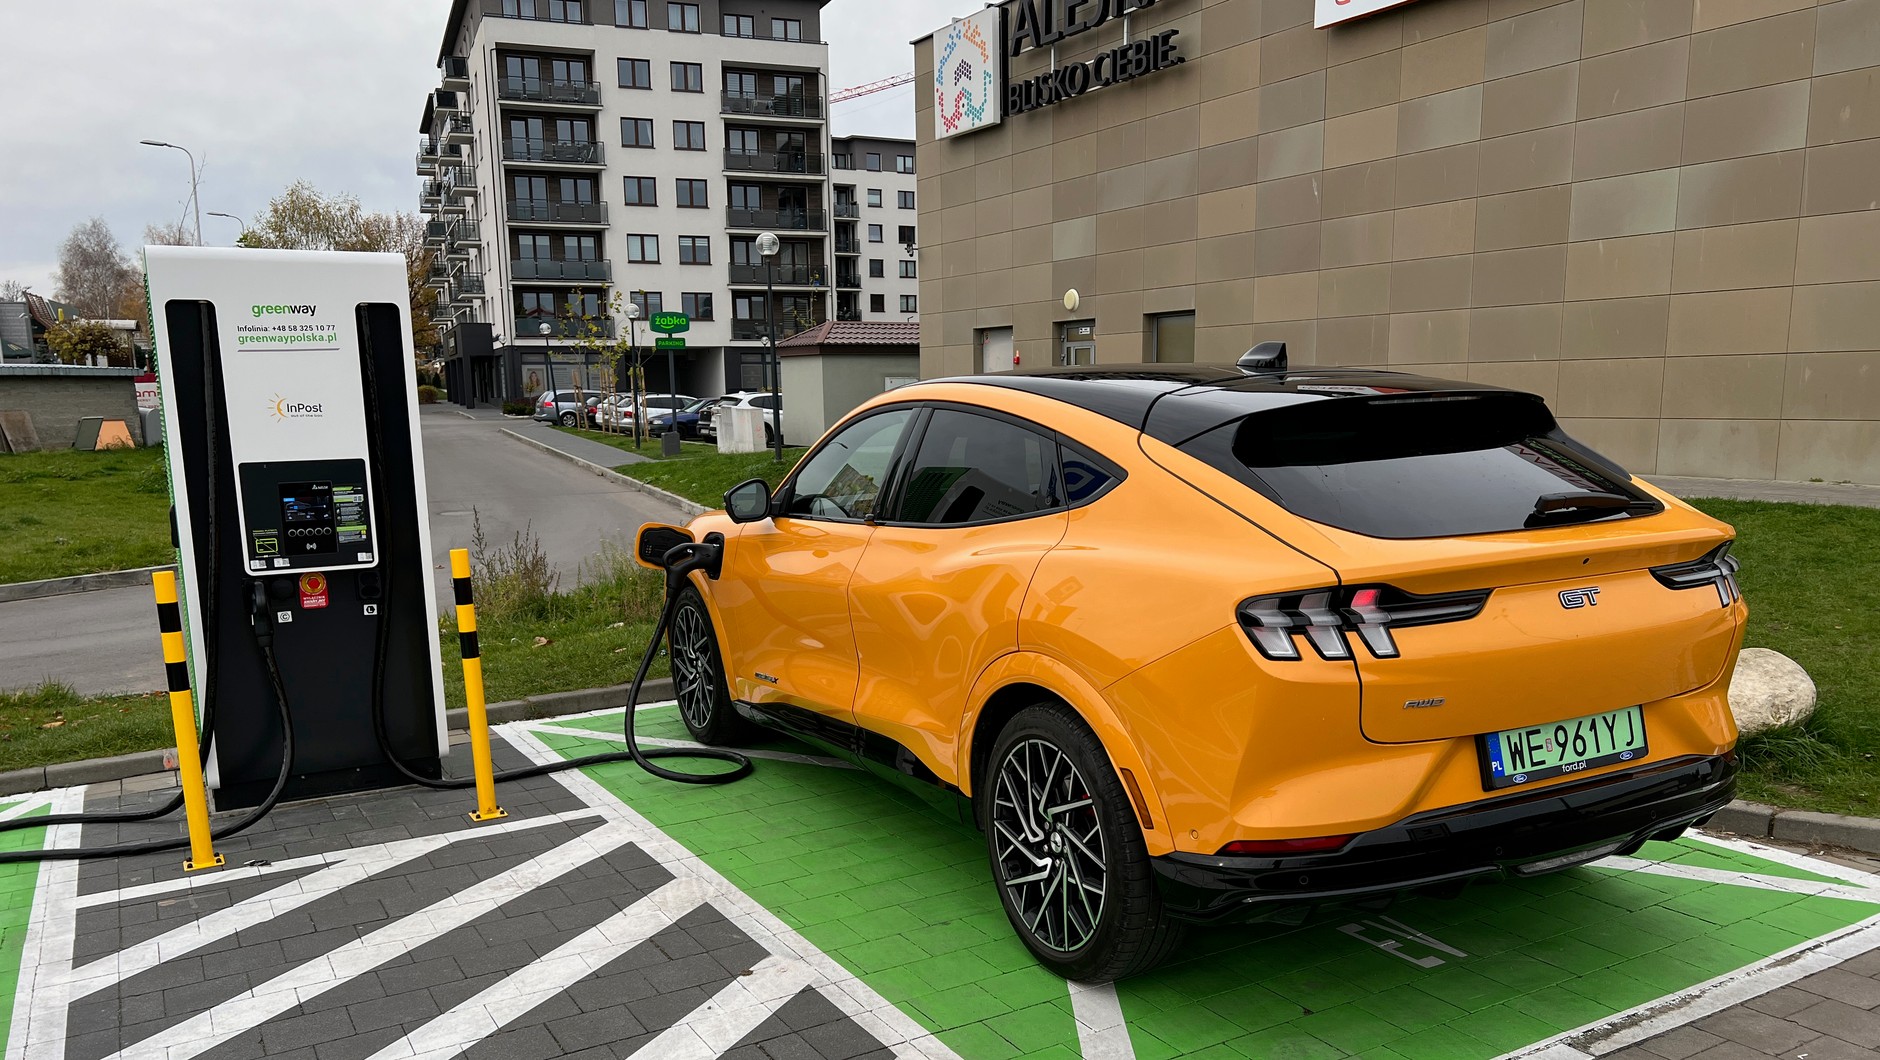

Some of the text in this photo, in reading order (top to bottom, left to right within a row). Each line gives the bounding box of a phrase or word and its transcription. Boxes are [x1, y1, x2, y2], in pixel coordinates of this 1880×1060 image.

[1009, 62, 1090, 115] BLISKO
[252, 303, 317, 317] greenway
[655, 316, 687, 325] żabka
[238, 332, 337, 345] greenwaypolska.pl
[286, 403, 323, 413] InPost
[1558, 586, 1601, 609] GT
[1403, 696, 1446, 709] AWD
[1506, 711, 1635, 771] WE 961YJ
[1492, 761, 1502, 772] PL
[1562, 760, 1587, 773] ford.pl
[1336, 915, 1468, 969] EV
